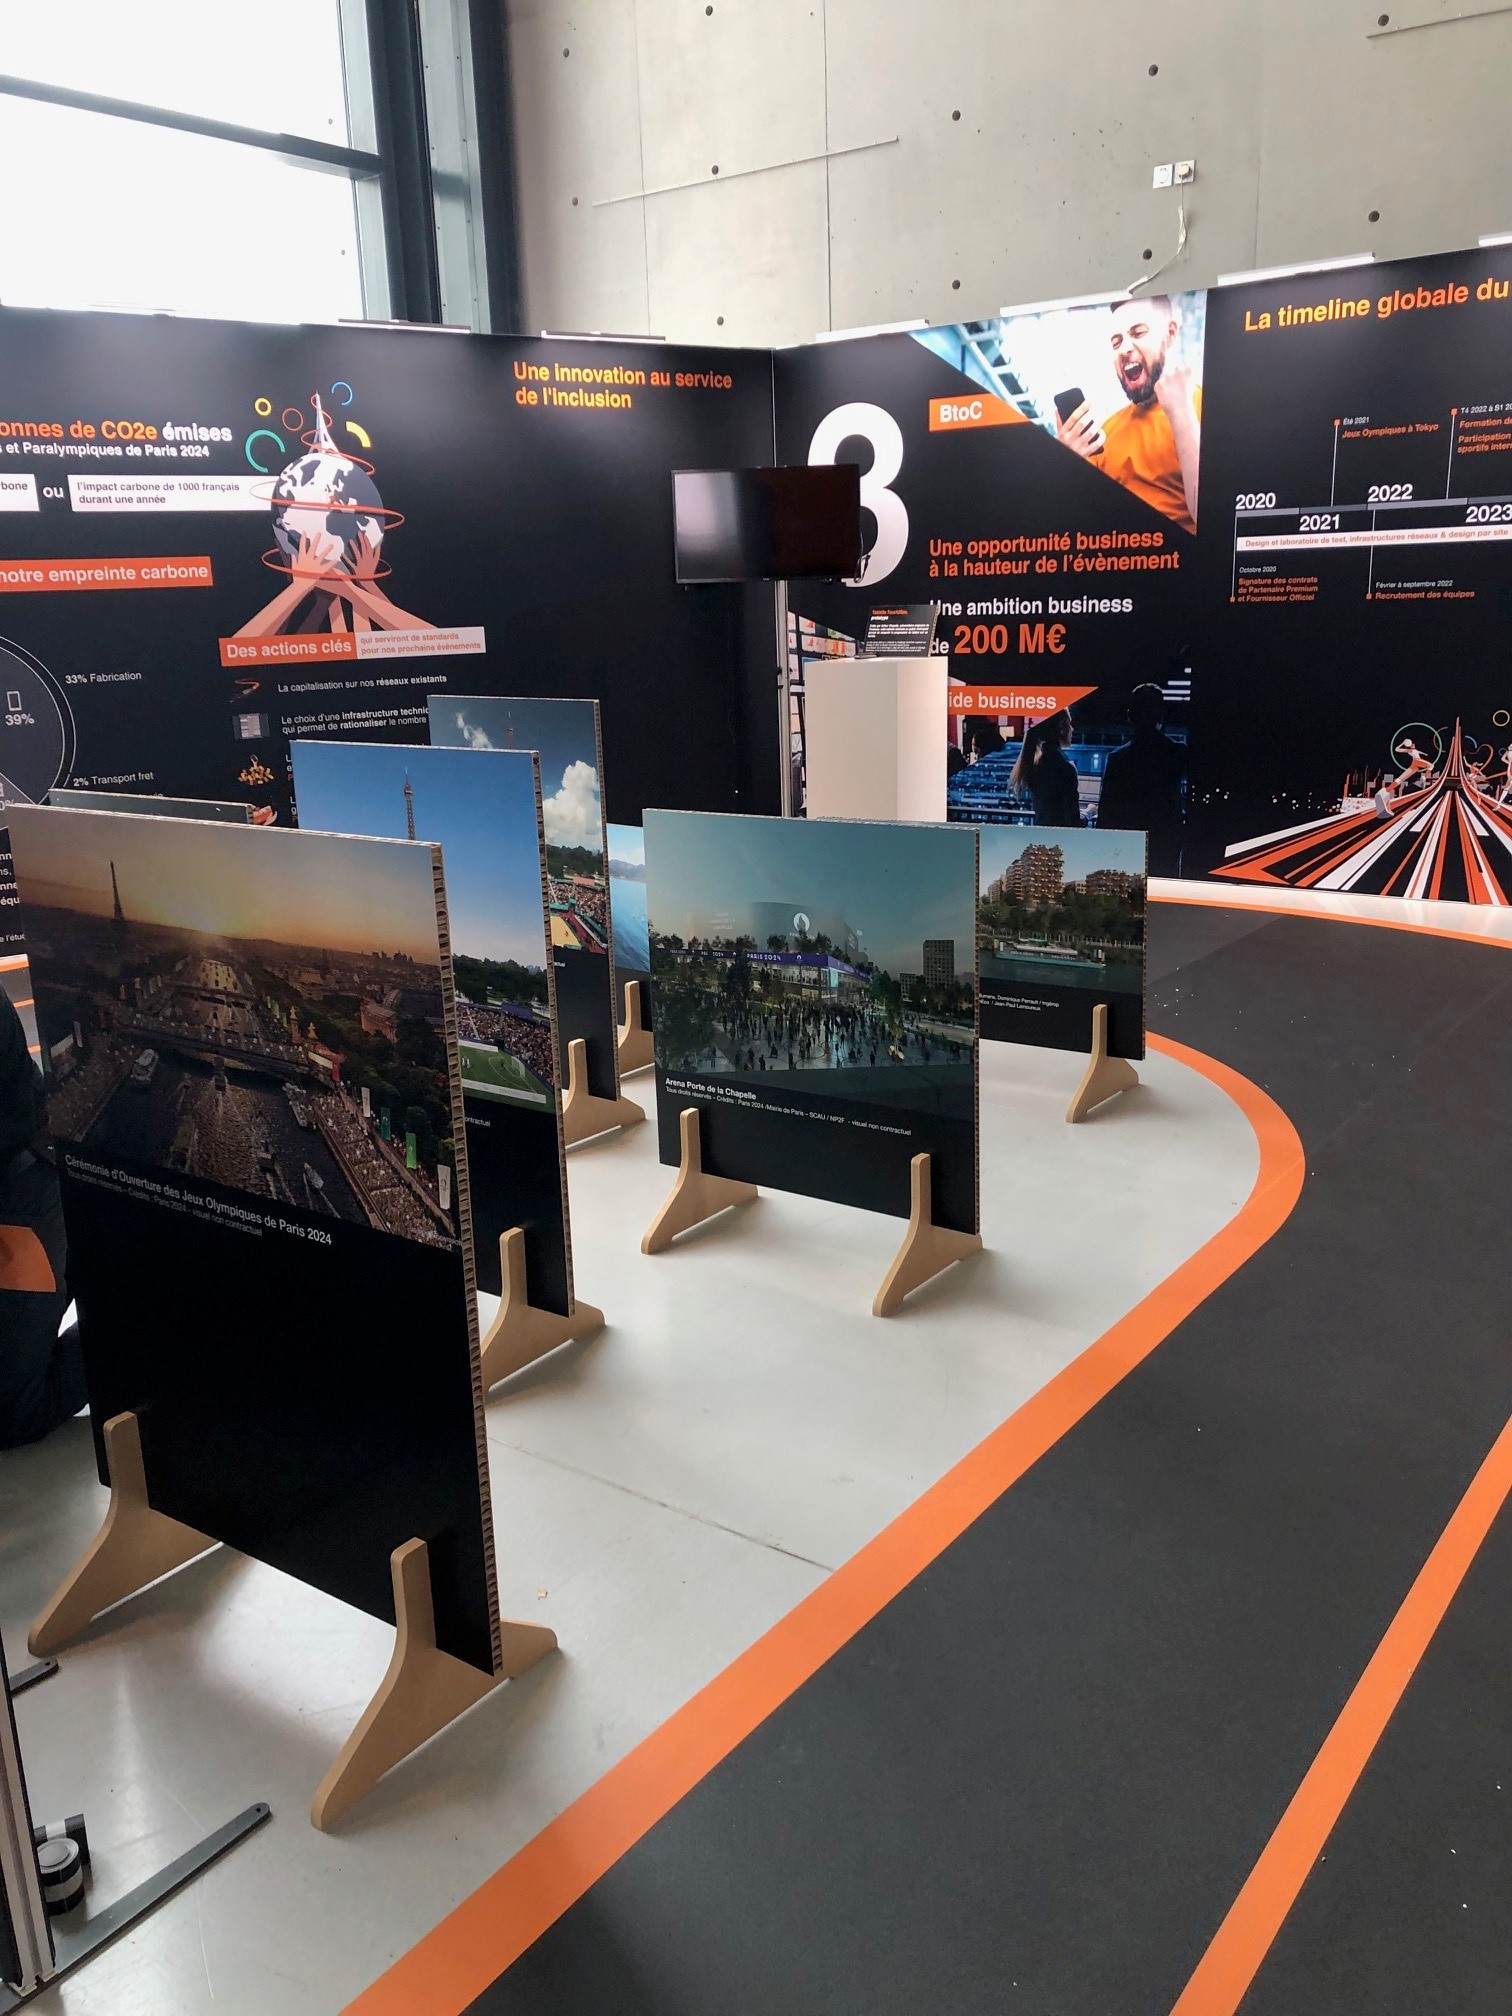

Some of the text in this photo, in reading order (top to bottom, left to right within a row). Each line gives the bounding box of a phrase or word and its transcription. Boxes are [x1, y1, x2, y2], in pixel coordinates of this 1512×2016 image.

[1245, 278, 1510, 331] La timeline globale du
[514, 361, 732, 388] Une innovation au service
[516, 387, 631, 408] de l'inclusion
[940, 401, 982, 423] BtoC
[1470, 406, 1487, 414] 2022
[1354, 416, 1370, 424] 2021
[1460, 419, 1502, 428] Formation
[70, 420, 95, 438] de
[101, 420, 157, 440] CO2e
[162, 421, 233, 441] émises
[1342, 429, 1361, 439] Jeux
[1415, 423, 1439, 432] Tokyo
[1458, 433, 1510, 443] Participation
[6, 442, 20, 454] et
[22, 442, 122, 458] Paralympiques
[125, 444, 142, 456] de
[144, 444, 178, 457] Paris
[180, 445, 210, 457] 2024
[1458, 444, 1489, 454] sportifs
[0, 482, 28, 490] bone
[42, 486, 64, 498] ou
[77, 482, 240, 493] l'impact carbone de 1000 français
[1368, 484, 1413, 502] 2022
[79, 495, 166, 504] durant une année
[1235, 492, 1276, 510] 2020
[1466, 504, 1512, 522] 2023
[1299, 514, 1340, 531] 2021
[930, 530, 1164, 558] Une opportunité business
[1246, 540, 1269, 548] Design
[1280, 538, 1319, 546] laboratoire
[1350, 534, 1405, 542] infrastructures
[1449, 530, 1475, 539] design
[1494, 528, 1508, 536] site
[929, 551, 1179, 577] à la hauteur de l'évènement
[0, 565, 208, 584] notre empreinte carbone
[1239, 578, 1271, 586] Signature
[1288, 576, 1318, 584] contrats
[1443, 590, 1475, 598] équipes
[930, 595, 1133, 616] Une ambition business
[361, 637, 373, 645] qui
[375, 635, 407, 644] serviront
[422, 633, 459, 642] standards
[930, 638, 949, 654] de
[954, 624, 1008, 654] 200
[1019, 623, 1066, 654] M€
[227, 639, 352, 658] Des actions clés
[361, 642, 481, 656] pour nos prochains évènements
[65, 672, 141, 684] 33% Fabrication
[278, 684, 288, 693] La
[291, 680, 343, 692] capitalisation
[346, 681, 358, 689] sur
[376, 678, 409, 686] réseaux
[411, 674, 447, 684] existants
[978, 692, 1056, 710] business
[5, 713, 35, 726] 39%
[282, 716, 292, 724] Le
[294, 714, 315, 723] choix
[318, 713, 340, 722] d'une
[342, 710, 398, 719] infrastructure
[282, 725, 295, 735] qui
[297, 723, 325, 734] permet
[328, 722, 338, 730] de
[340, 717, 387, 729] rationaliser
[398, 716, 426, 724] nombre
[73, 772, 154, 786] 2% Transport fret
[666, 1078, 685, 1088] Arena
[687, 1081, 705, 1091] Porte
[707, 1085, 716, 1093] de
[725, 1088, 756, 1100] Chapelle
[880, 1125, 911, 1135] contractuel
[66, 1154, 332, 1245] Cérémonie d'Ouverture des Jeux Olympiques de Paris 2024
